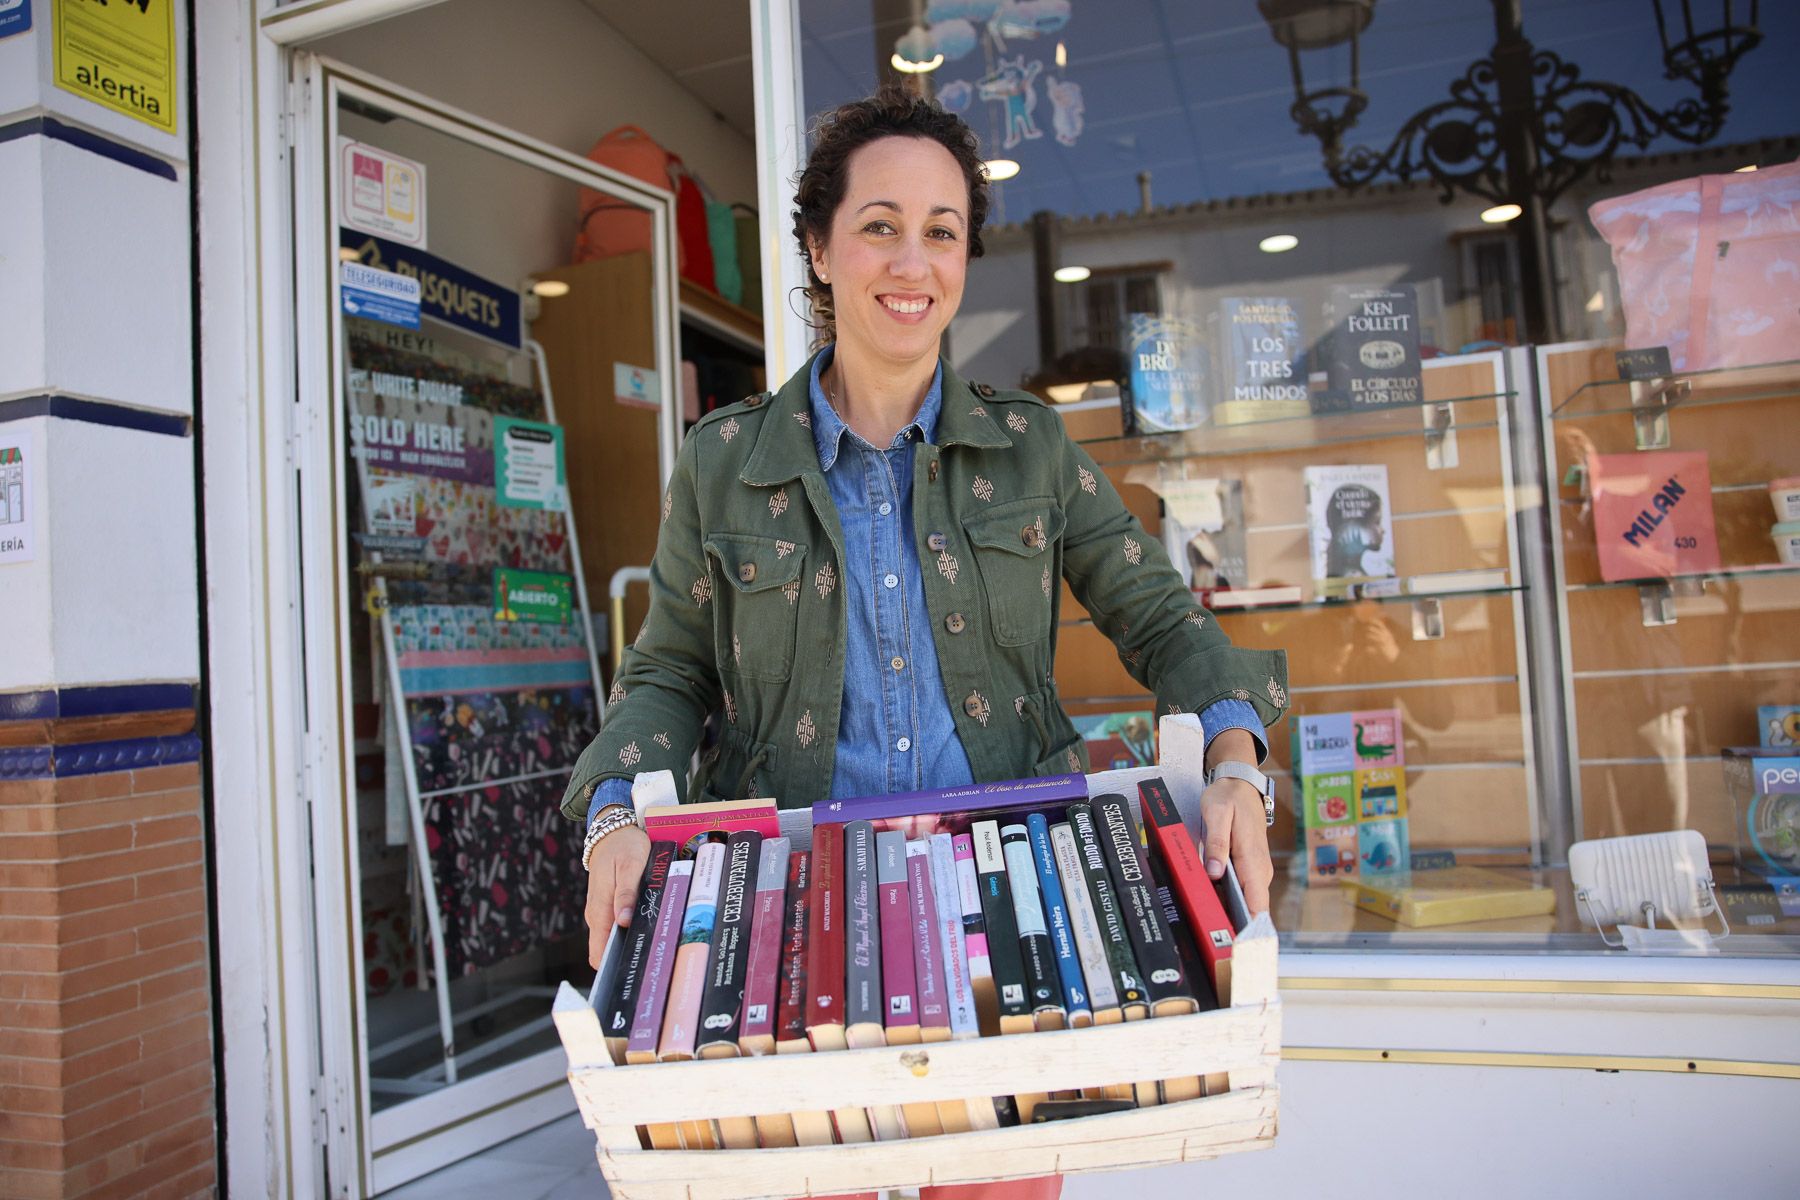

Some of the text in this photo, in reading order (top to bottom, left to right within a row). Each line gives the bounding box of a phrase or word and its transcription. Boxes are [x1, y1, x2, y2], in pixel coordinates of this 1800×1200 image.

[1363, 302, 1393, 316] KEN
[1348, 314, 1411, 333] FOLLETT
[387, 330, 434, 350] HEY!
[1252, 337, 1284, 352] LOS
[1246, 360, 1293, 378] TRES
[371, 371, 416, 399] WHITE
[1234, 385, 1308, 401] MUNDOS
[1352, 379, 1365, 391] EL
[1365, 391, 1389, 403] LOS
[350, 415, 466, 453] SOLD HERE
[1622, 478, 1686, 547] MILAN
[0, 537, 24, 552] ERÍA
[1674, 536, 1697, 549] 430
[508, 589, 558, 607] ABIERTO
[958, 789, 980, 797] ADRIAN
[984, 784, 996, 794] El
[996, 783, 1012, 793] beso
[1013, 782, 1023, 791] de
[1024, 777, 1072, 790] medianoche
[1763, 768, 1800, 795] pe
[1075, 812, 1094, 839] FONDO
[856, 828, 867, 871] SARAH HALL
[985, 841, 994, 861] Anderson
[1083, 845, 1103, 870] RUIDO
[722, 841, 750, 923] CELEBUTANTES
[1102, 803, 1153, 943] Amanda Goldberg CELEBUTANTES
[1096, 880, 1113, 912] GISTAU
[1156, 886, 1180, 924] ROBIN COOK
[622, 969, 638, 1000] SILVANA
[630, 933, 646, 969] GIACOBINI
[648, 851, 670, 889] LOREN
[793, 900, 804, 932] desatada
[1140, 885, 1163, 941] Ruthanna Hopper
[1052, 905, 1071, 958] Hernán Neira
[1106, 912, 1122, 942] DAVID
[723, 926, 739, 985] Ruthanna Hopper
[791, 932, 803, 952] Furia
[949, 937, 958, 949] DEL
[714, 928, 731, 987] Amanda Goldberg
[952, 949, 963, 989] OLVIDADOS
[1029, 935, 1043, 980] RICARDO VÁZQU
[956, 989, 965, 1003] LOS
